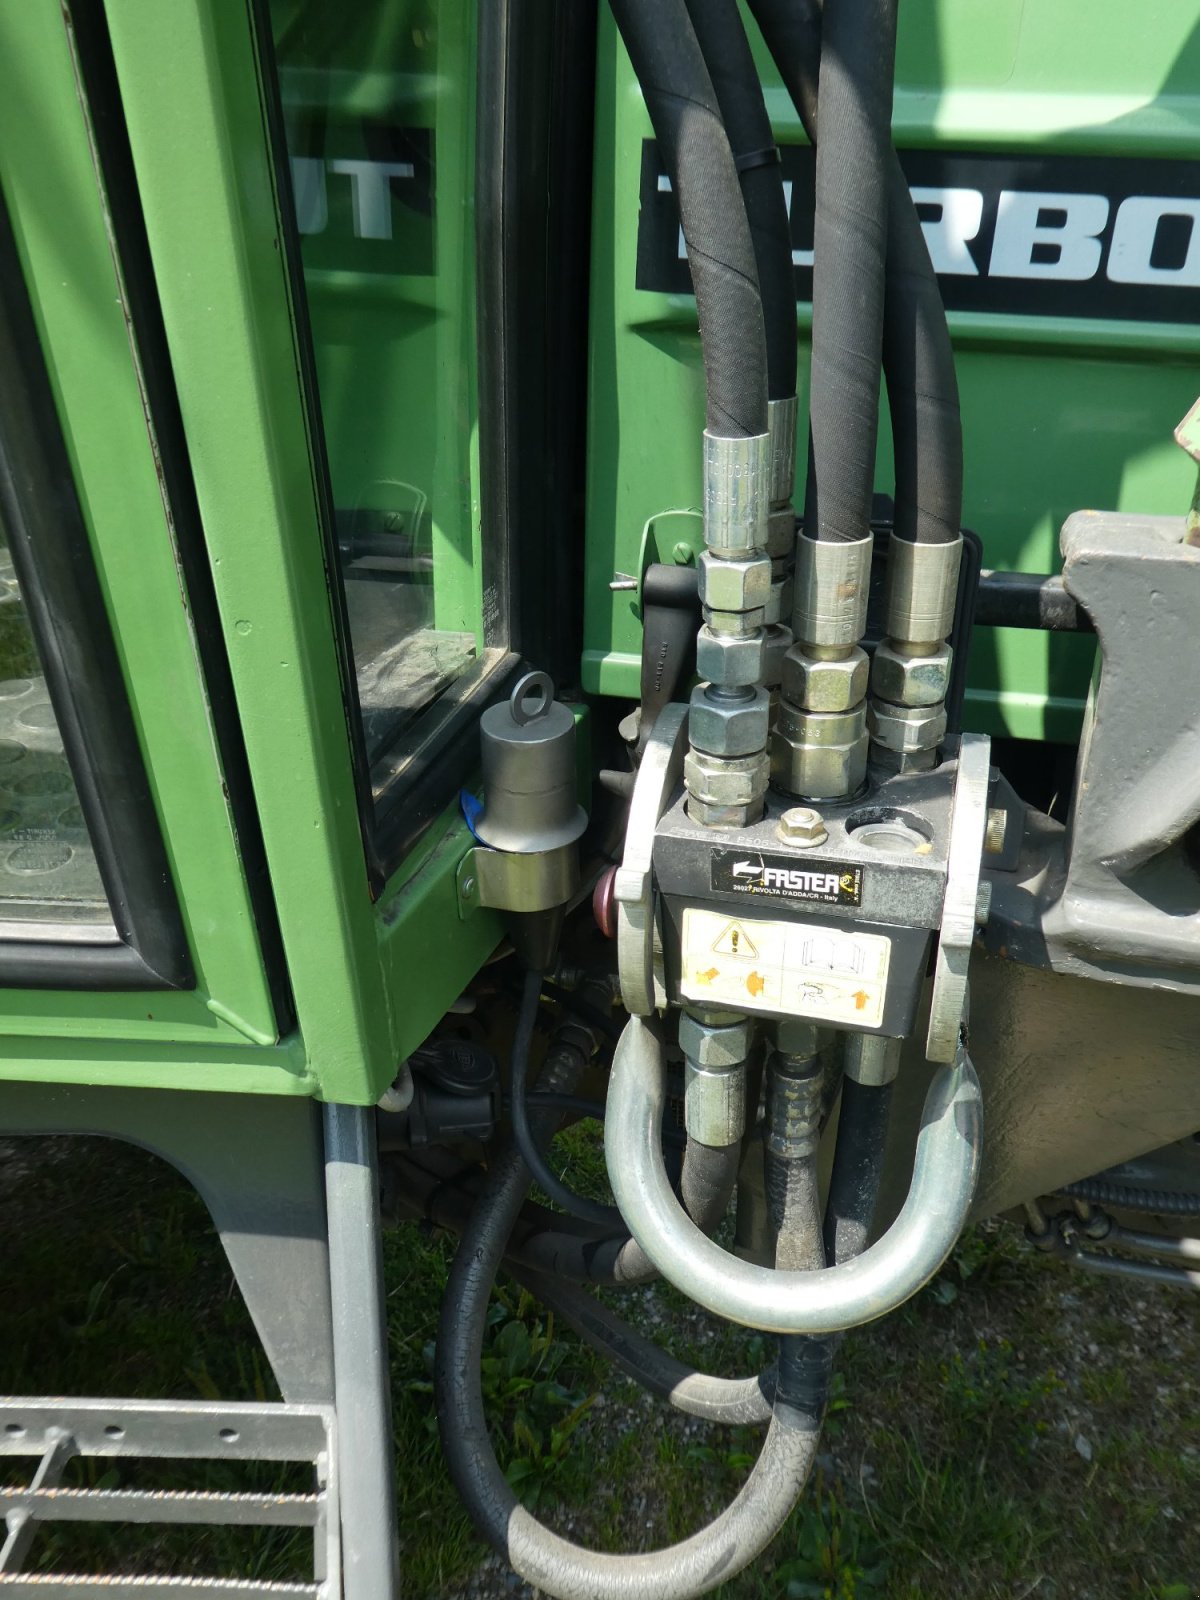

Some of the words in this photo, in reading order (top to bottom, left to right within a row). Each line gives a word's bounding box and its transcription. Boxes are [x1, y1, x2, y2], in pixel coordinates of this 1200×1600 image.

[657, 175, 1200, 287] RBO
[764, 867, 839, 894] FASTER
[753, 886, 781, 896] RIVOLTA
[824, 895, 839, 903] Italy
